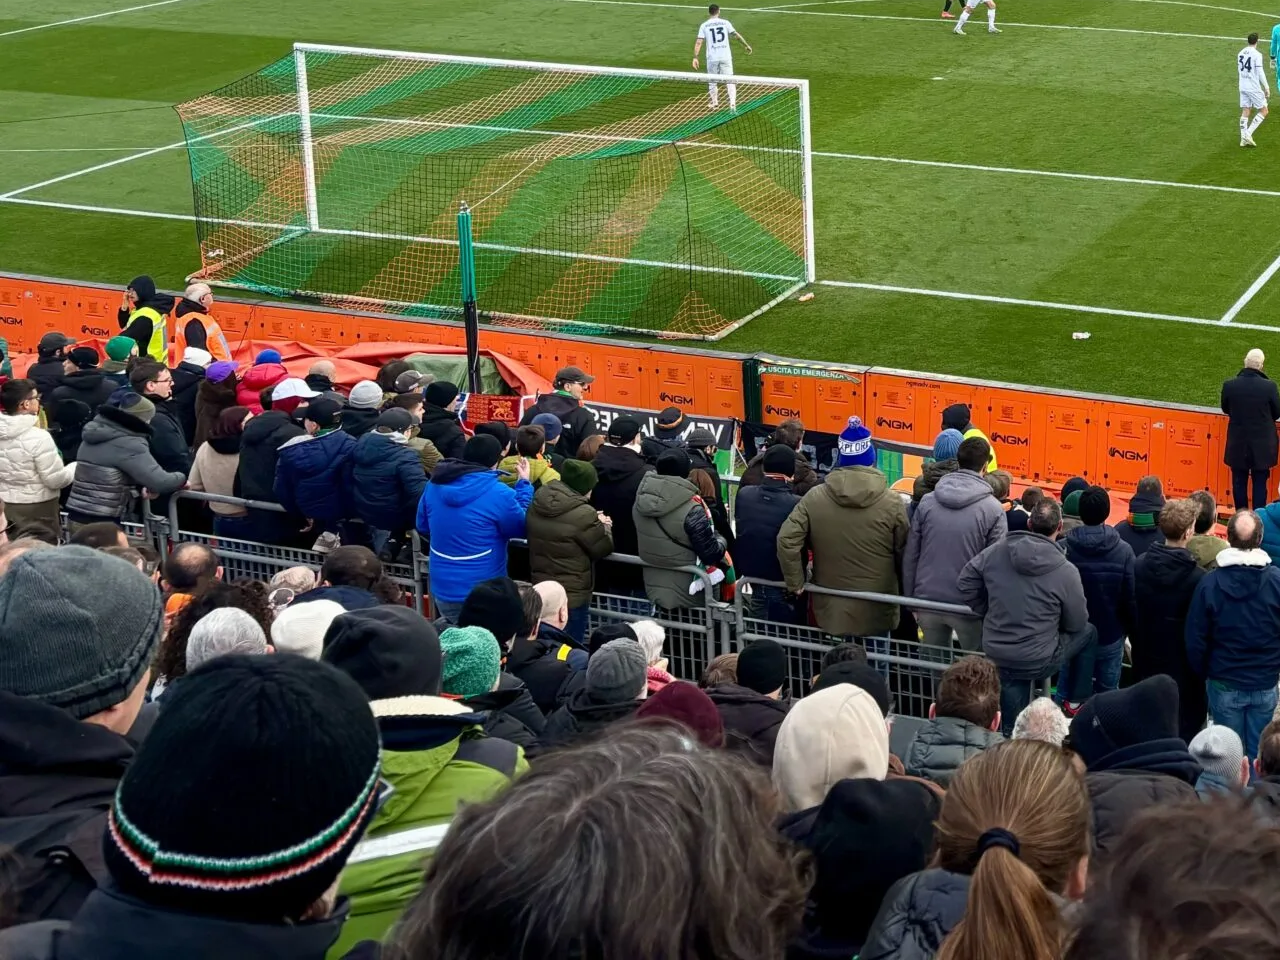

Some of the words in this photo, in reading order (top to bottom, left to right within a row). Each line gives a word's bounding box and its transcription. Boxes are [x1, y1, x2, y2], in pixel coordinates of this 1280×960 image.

[709, 27, 725, 44] 13
[1239, 54, 1252, 73] 34
[85, 326, 110, 337] NGM
[768, 366, 791, 374] USCITA
[793, 367, 800, 375] DI
[801, 368, 844, 379] EMERGENZA
[663, 393, 693, 406] NGM
[769, 406, 800, 419] NGM
[881, 418, 913, 431] NGM
[996, 433, 1029, 447] NGM
[1114, 448, 1148, 462] NGM
